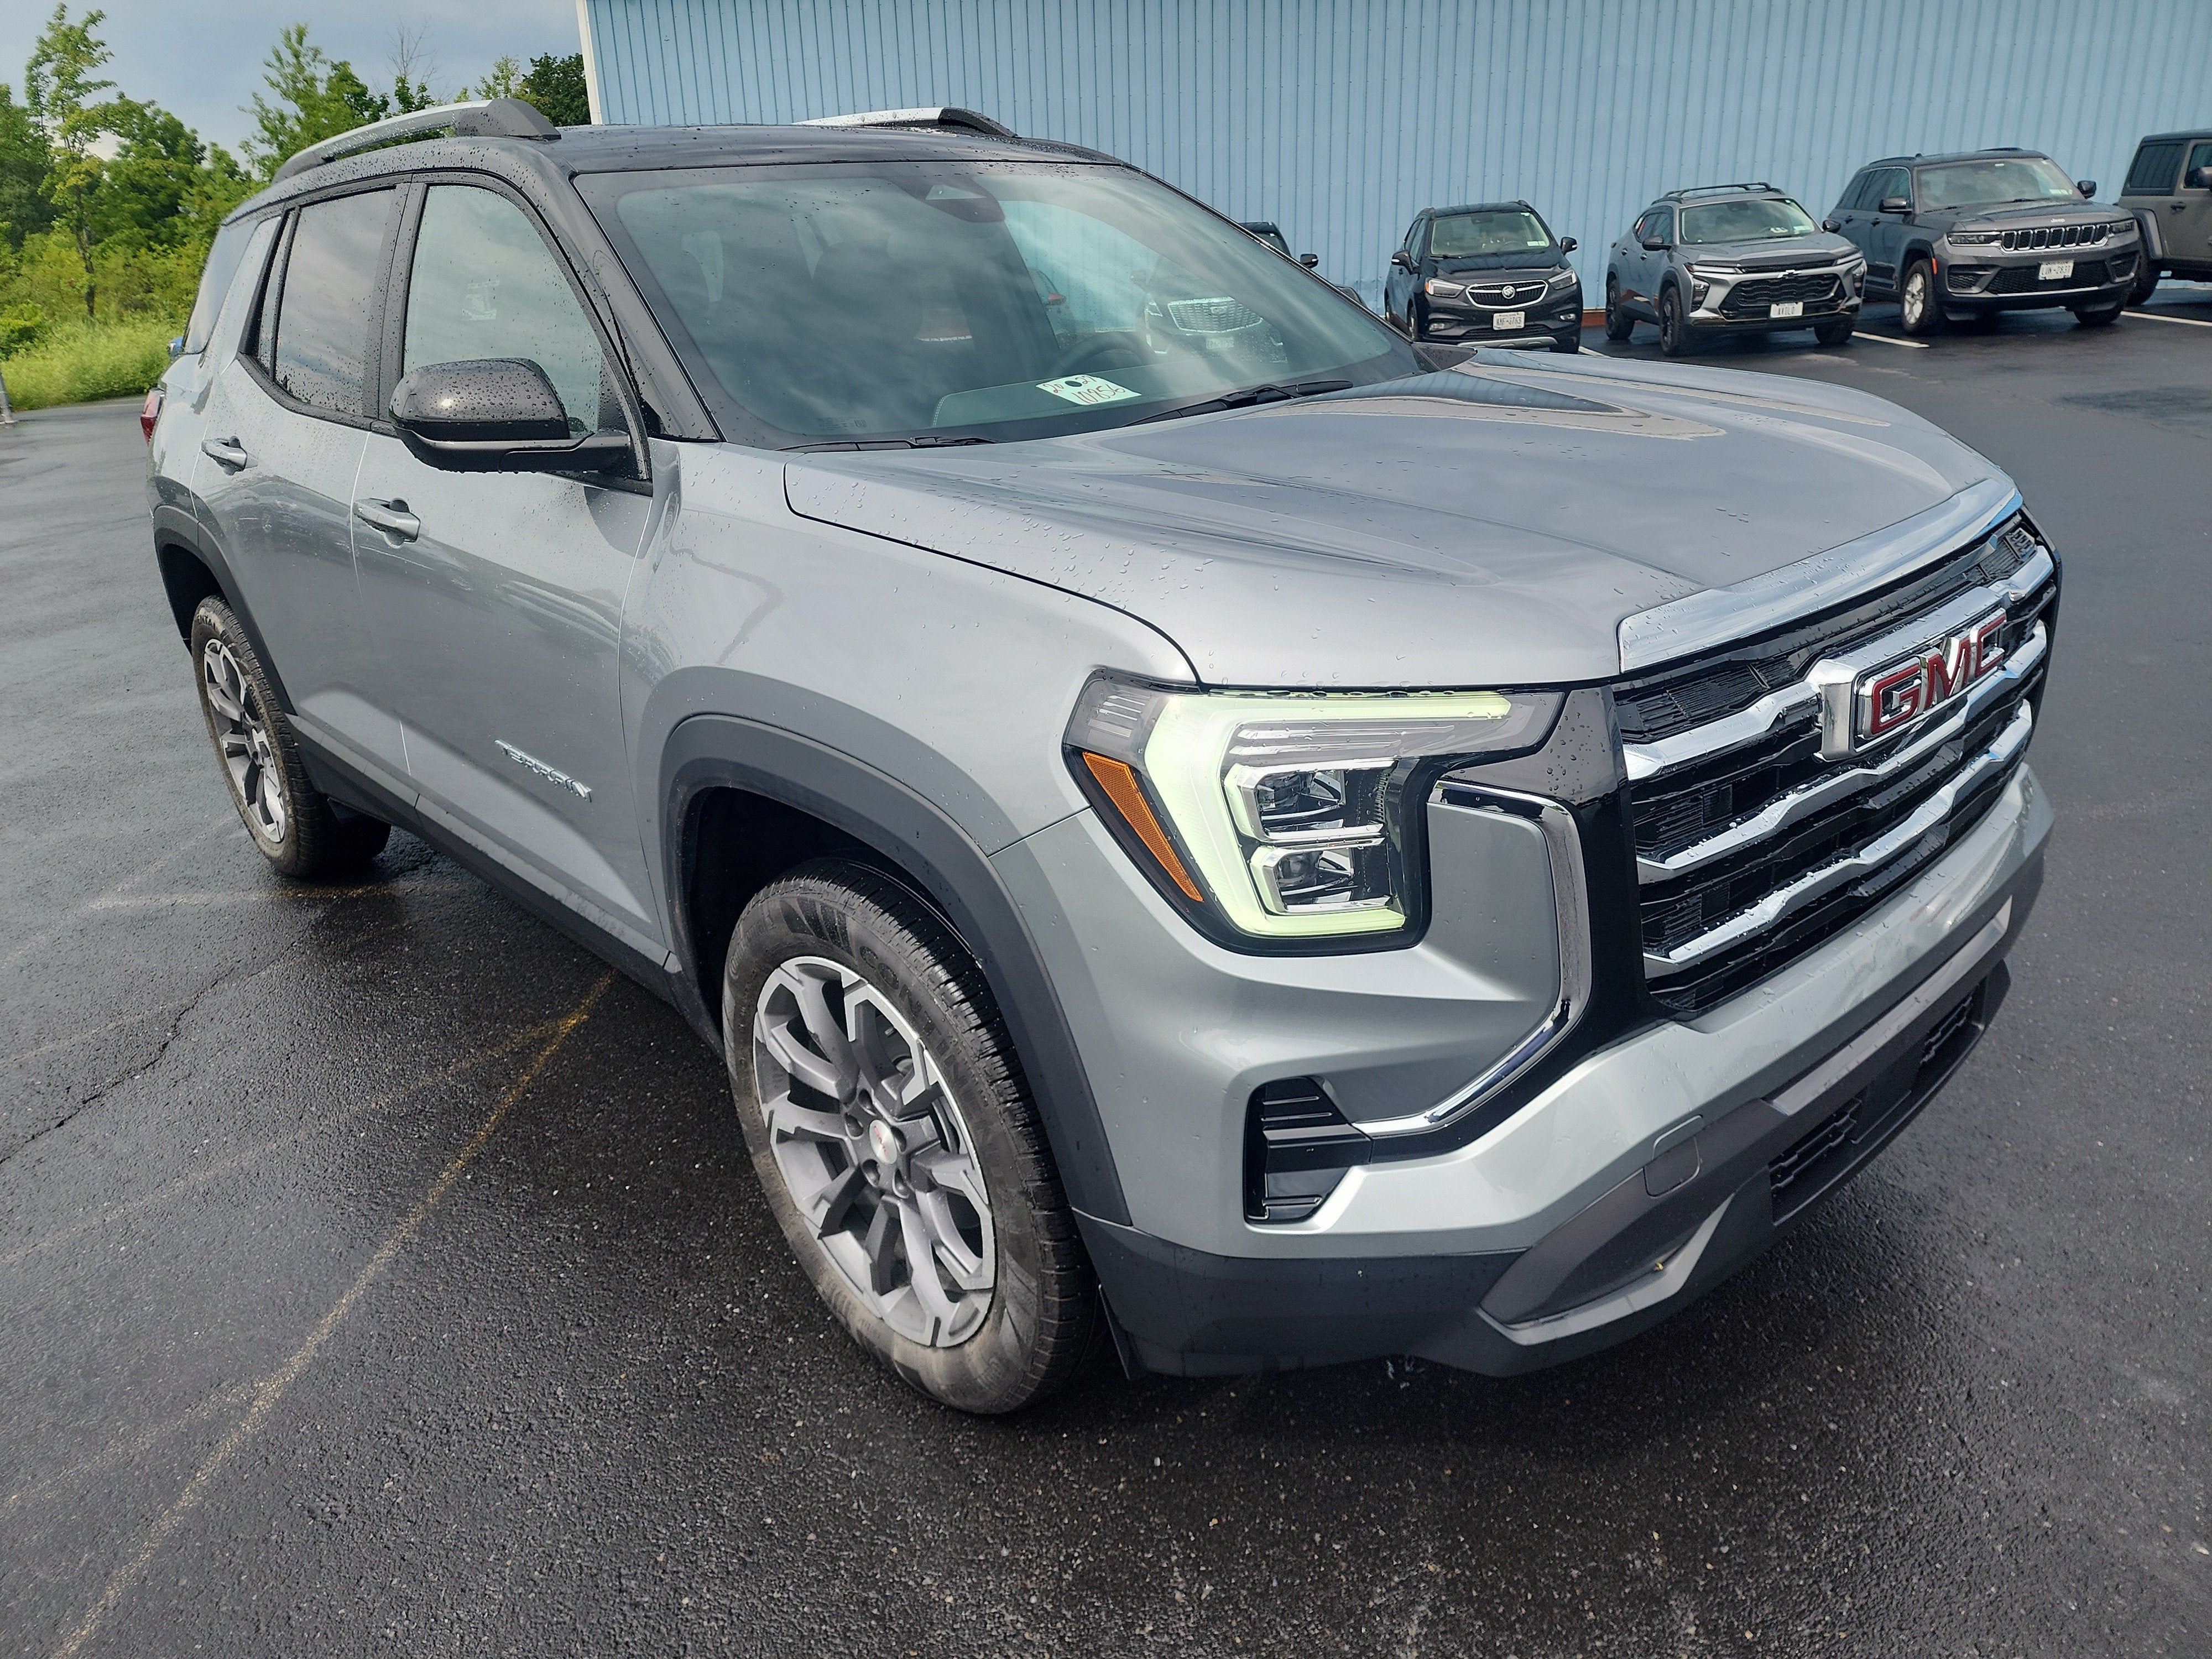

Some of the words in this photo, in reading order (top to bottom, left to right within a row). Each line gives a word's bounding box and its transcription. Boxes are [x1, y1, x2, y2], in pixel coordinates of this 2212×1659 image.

[1042, 383, 1065, 393] 20
[1075, 375, 1097, 384] 27
[1860, 607, 2007, 739] GMC
